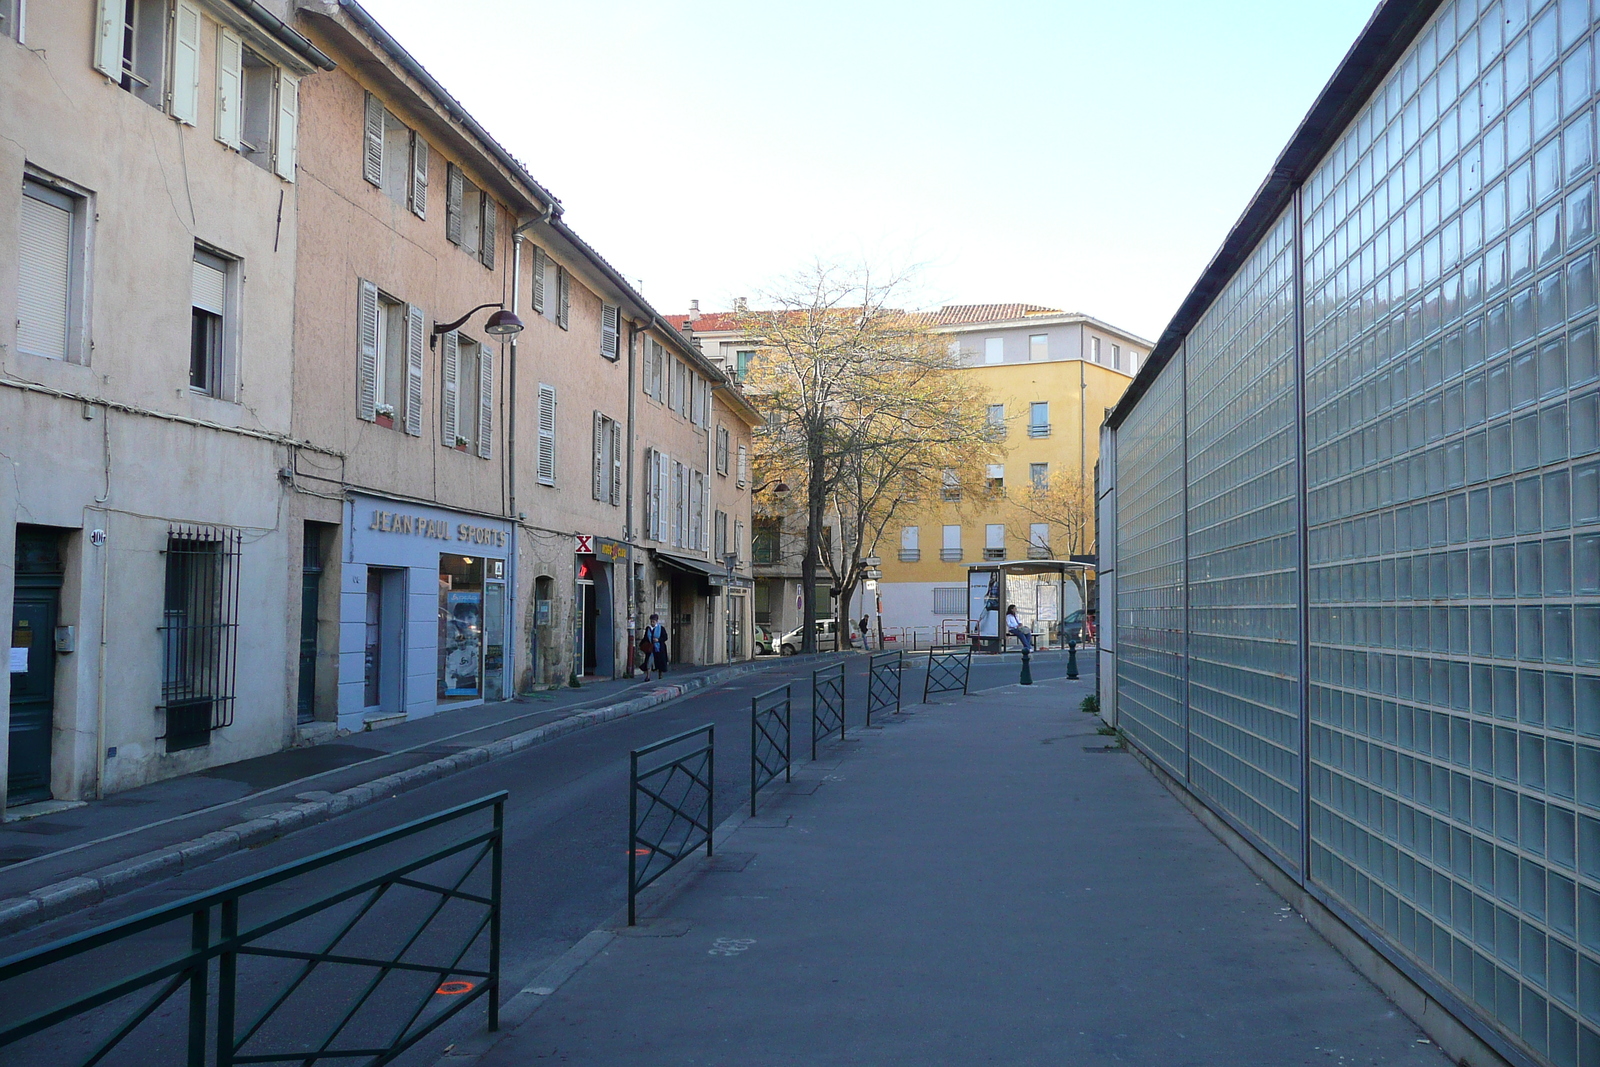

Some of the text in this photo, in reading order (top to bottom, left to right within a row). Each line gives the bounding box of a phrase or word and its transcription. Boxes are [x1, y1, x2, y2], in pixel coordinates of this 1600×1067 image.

[370, 510, 506, 547] JEAN PAUL SPORTS
[575, 535, 592, 553] X
